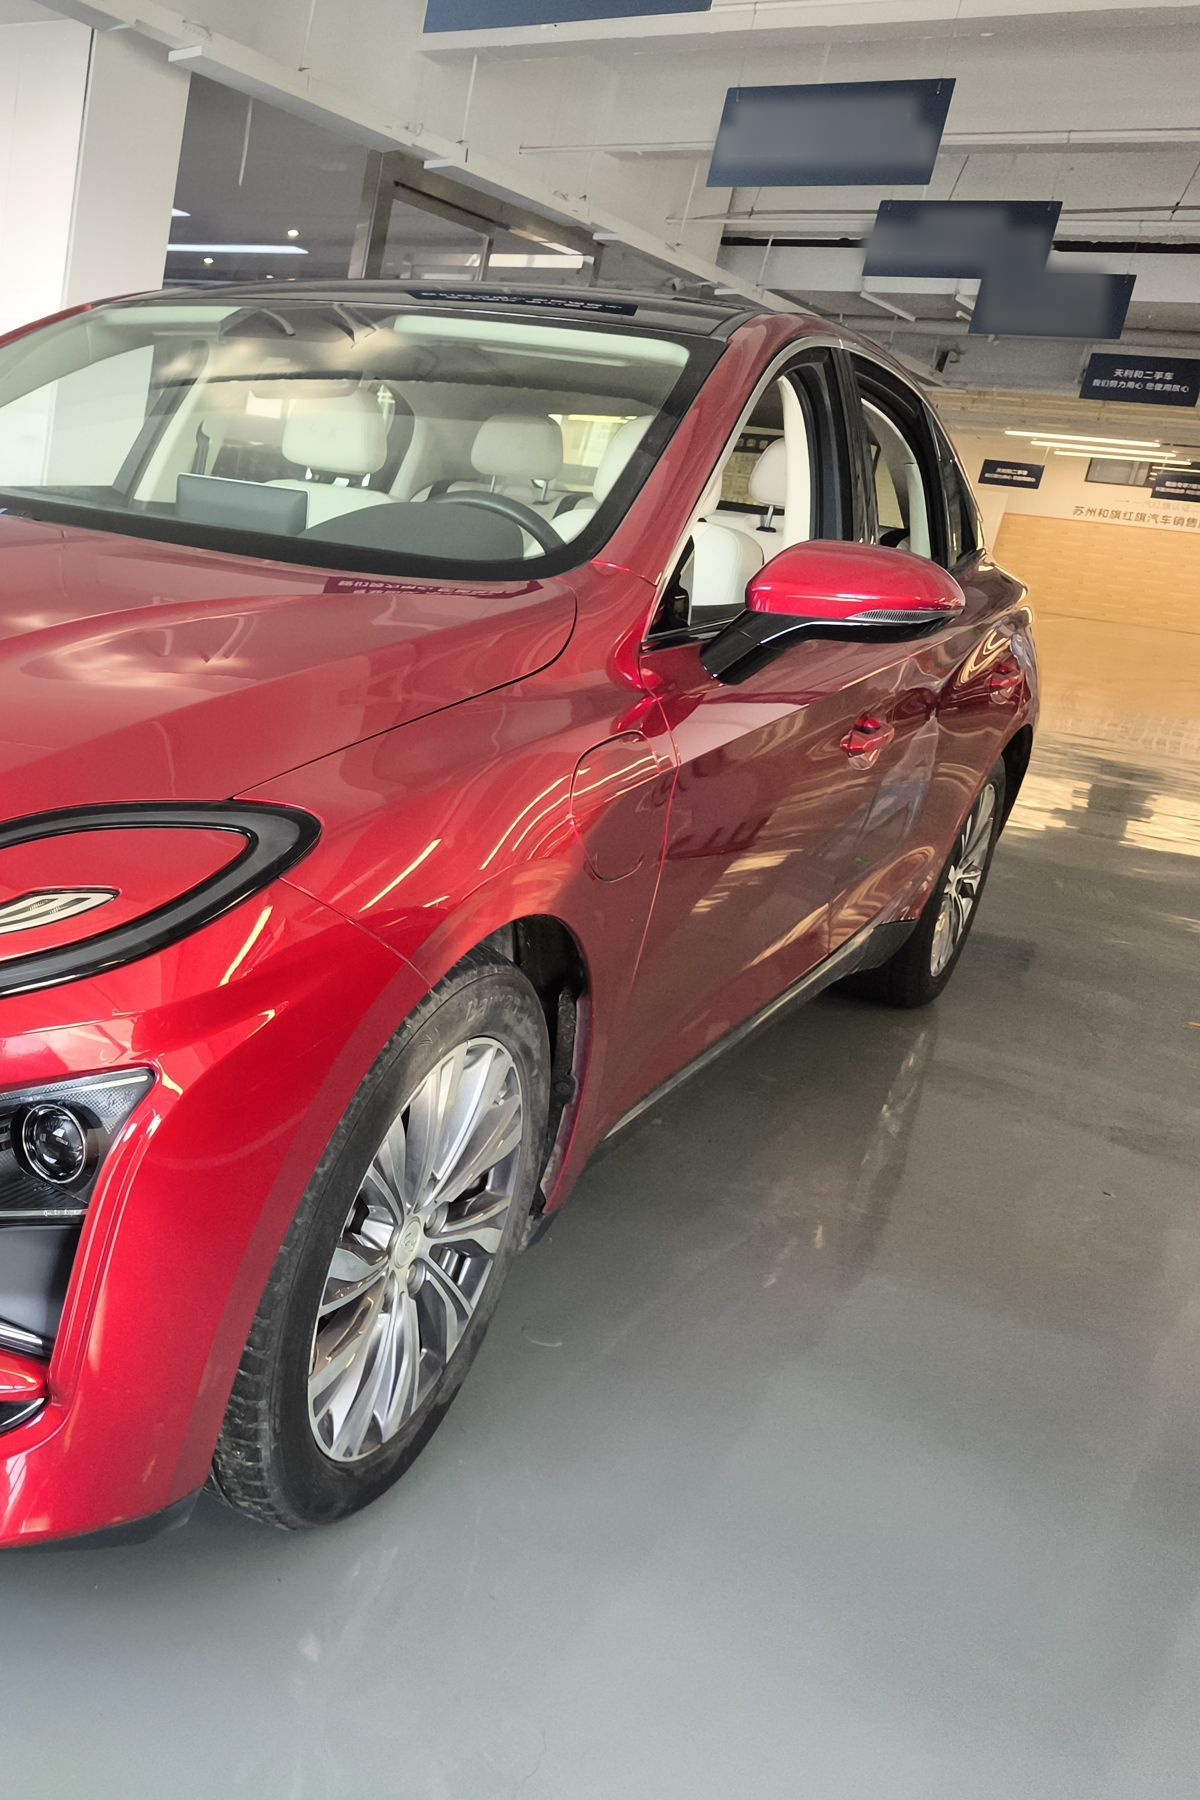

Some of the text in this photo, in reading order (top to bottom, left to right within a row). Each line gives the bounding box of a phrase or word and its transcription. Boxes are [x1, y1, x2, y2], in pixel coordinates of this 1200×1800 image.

[1072, 505, 1200, 529] 苏州和旗红旗汽车销售
